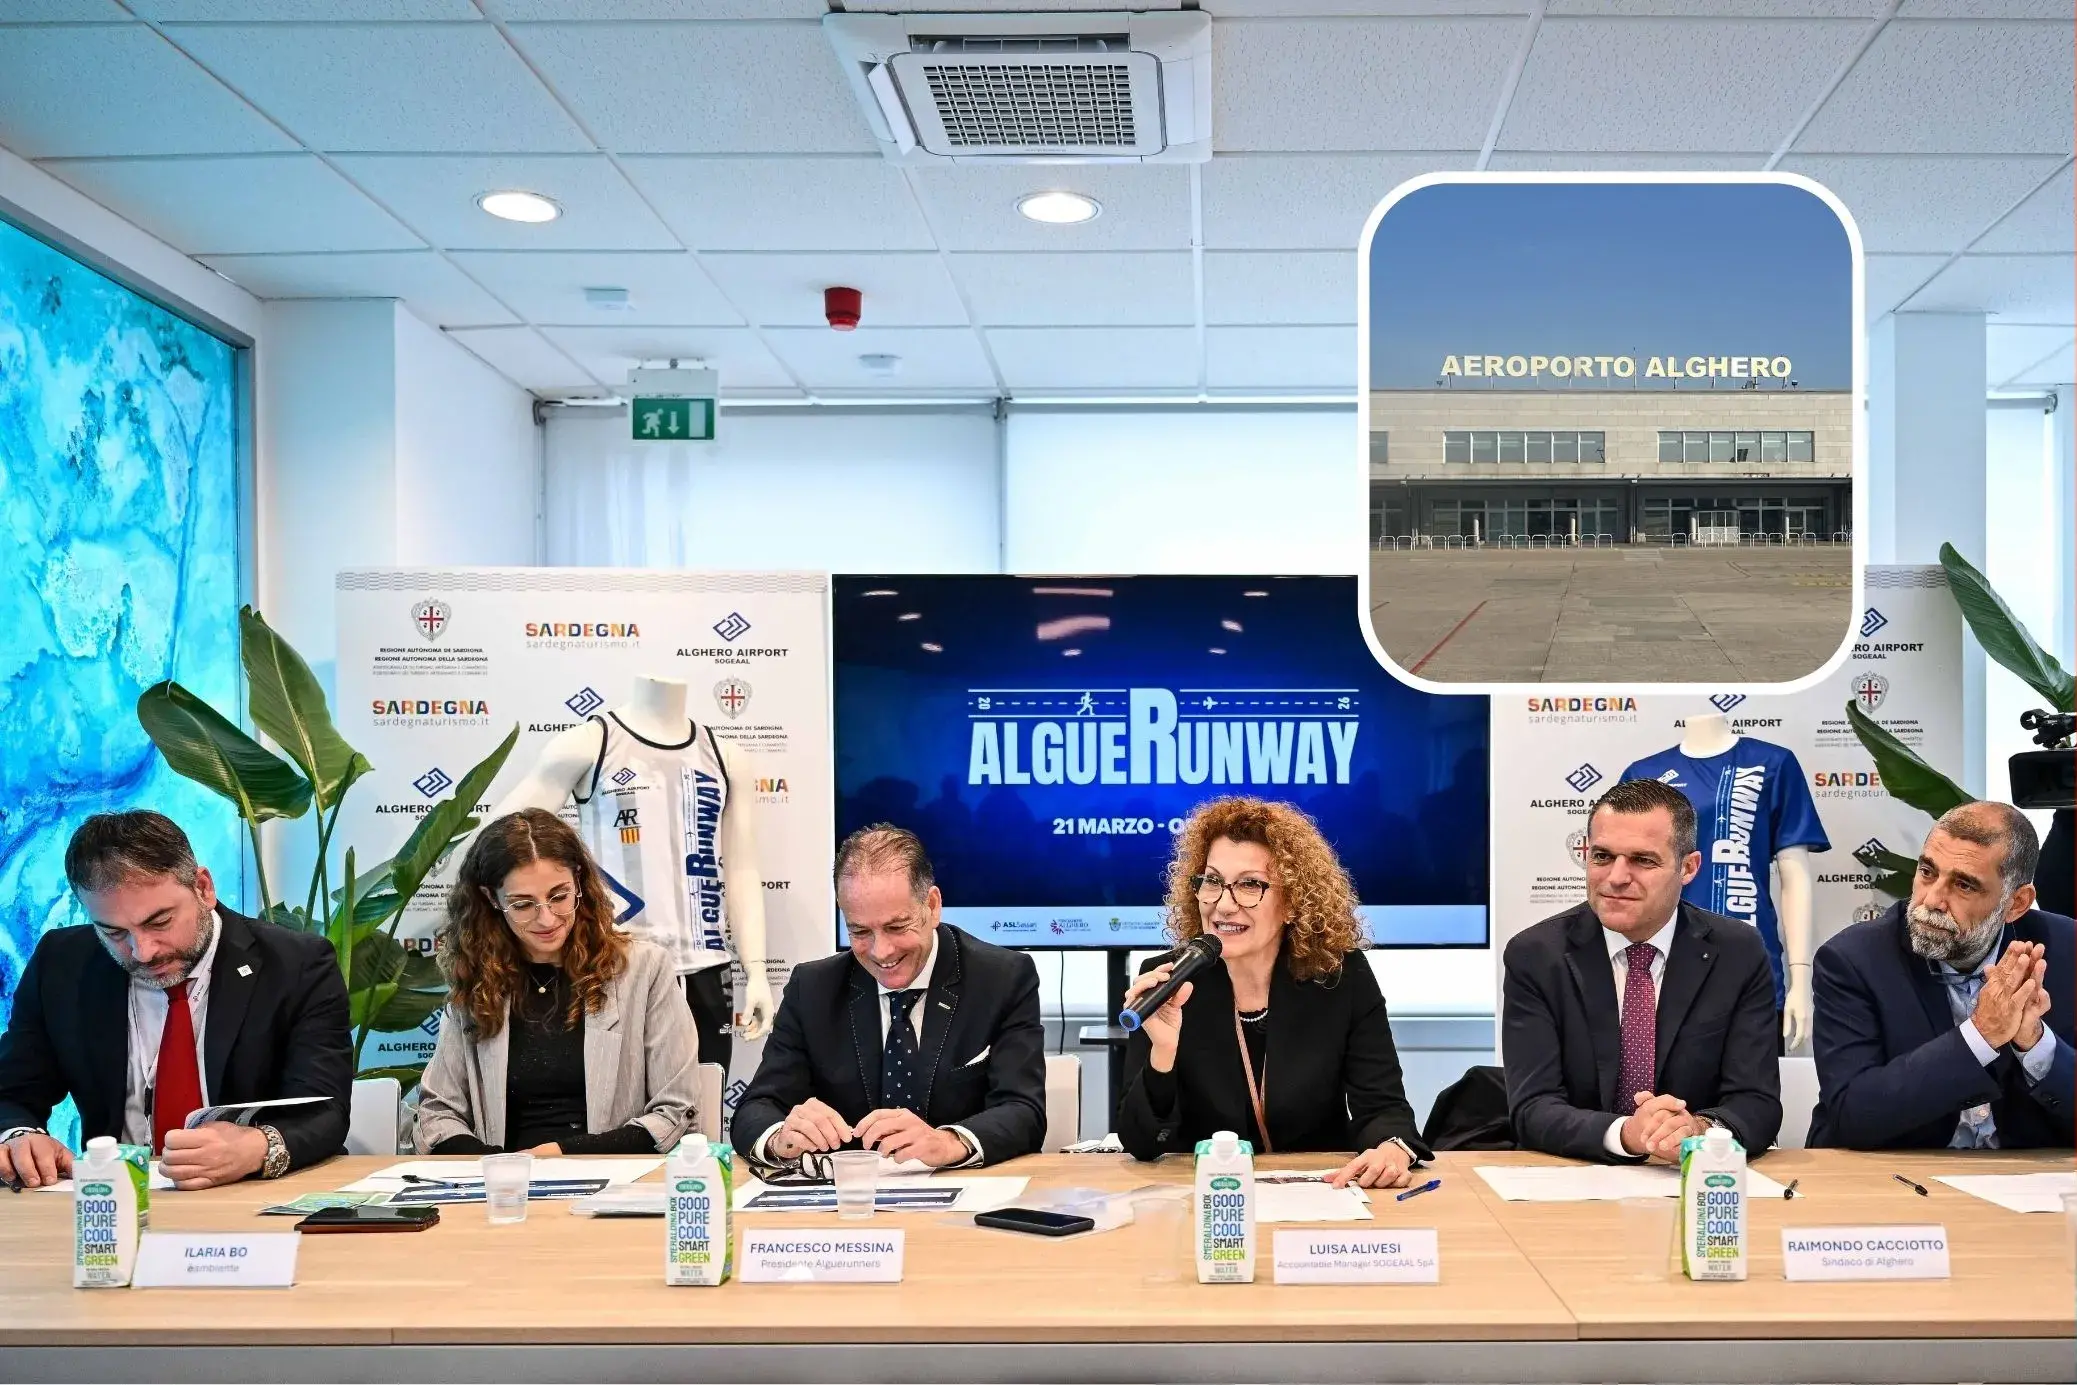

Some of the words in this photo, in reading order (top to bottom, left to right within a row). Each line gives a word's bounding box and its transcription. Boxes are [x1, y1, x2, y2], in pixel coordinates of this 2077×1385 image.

[1441, 355, 1635, 377] AEROPORTO
[1645, 356, 1792, 378] ALGHERO
[526, 623, 640, 637] SARDEGNA
[526, 639, 641, 651] sardegnaturismo.it
[1873, 643, 1924, 652] AIRPORT
[676, 648, 733, 657] ALGHERO
[737, 648, 789, 657] AIRPORT
[372, 700, 489, 715] SARDEGNA
[1528, 698, 1637, 712] SARDEGNA
[373, 716, 490, 729] sardegnaturismo.it
[1528, 714, 1638, 725] sardegnaturismo.it
[1732, 719, 1783, 727] AIRPORT
[1815, 773, 1880, 787] SARDE
[375, 804, 433, 813] ALGHERO
[1530, 799, 1585, 808] ALGHERO
[1052, 818, 1075, 835] 21
[1077, 818, 1155, 835] MARZO
[1817, 874, 1872, 883] ALGHERO
[760, 881, 791, 890] PORT
[378, 1042, 437, 1052] ALGHERO
[678, 1196, 710, 1210] GOOD
[1213, 1194, 1245, 1208] GOOD
[1707, 1191, 1740, 1205] GOOD
[84, 1200, 117, 1213] GOOD
[678, 1211, 710, 1225] PURE
[1213, 1209, 1245, 1222] PURE
[1707, 1206, 1740, 1220] PURE
[84, 1214, 117, 1227] PURE
[678, 1226, 710, 1239] COOL
[1213, 1223, 1245, 1237] COOL
[1707, 1221, 1740, 1235] COOL
[84, 1229, 117, 1242] COOL
[1707, 1235, 1740, 1246] SMART
[84, 1243, 117, 1254] SMART
[678, 1241, 710, 1251] SMART
[750, 1242, 831, 1254] FRANCESCO
[835, 1242, 894, 1253] MESSINA
[1213, 1238, 1245, 1249] SMART
[1309, 1244, 1348, 1255] LUISA
[1351, 1243, 1401, 1254] ALIVESI
[1788, 1241, 1863, 1252] RAIMONDO
[1866, 1239, 1944, 1251] CACCIOTTO
[184, 1247, 227, 1258] ILARIA
[229, 1247, 248, 1258] BO
[678, 1252, 710, 1263] GREEN
[1213, 1249, 1245, 1260] GREEN
[1707, 1247, 1740, 1258] GREEN
[84, 1255, 117, 1266] GREEN
[761, 1259, 814, 1268] Presidente
[815, 1259, 881, 1270] Alguerunners
[1277, 1260, 1332, 1269] Accountable
[1334, 1260, 1371, 1269] Manager
[1373, 1258, 1414, 1268] SOGEAAL
[1822, 1256, 1863, 1267] Sindaco
[1865, 1257, 1874, 1267] di
[1876, 1257, 1914, 1268] Alghero
